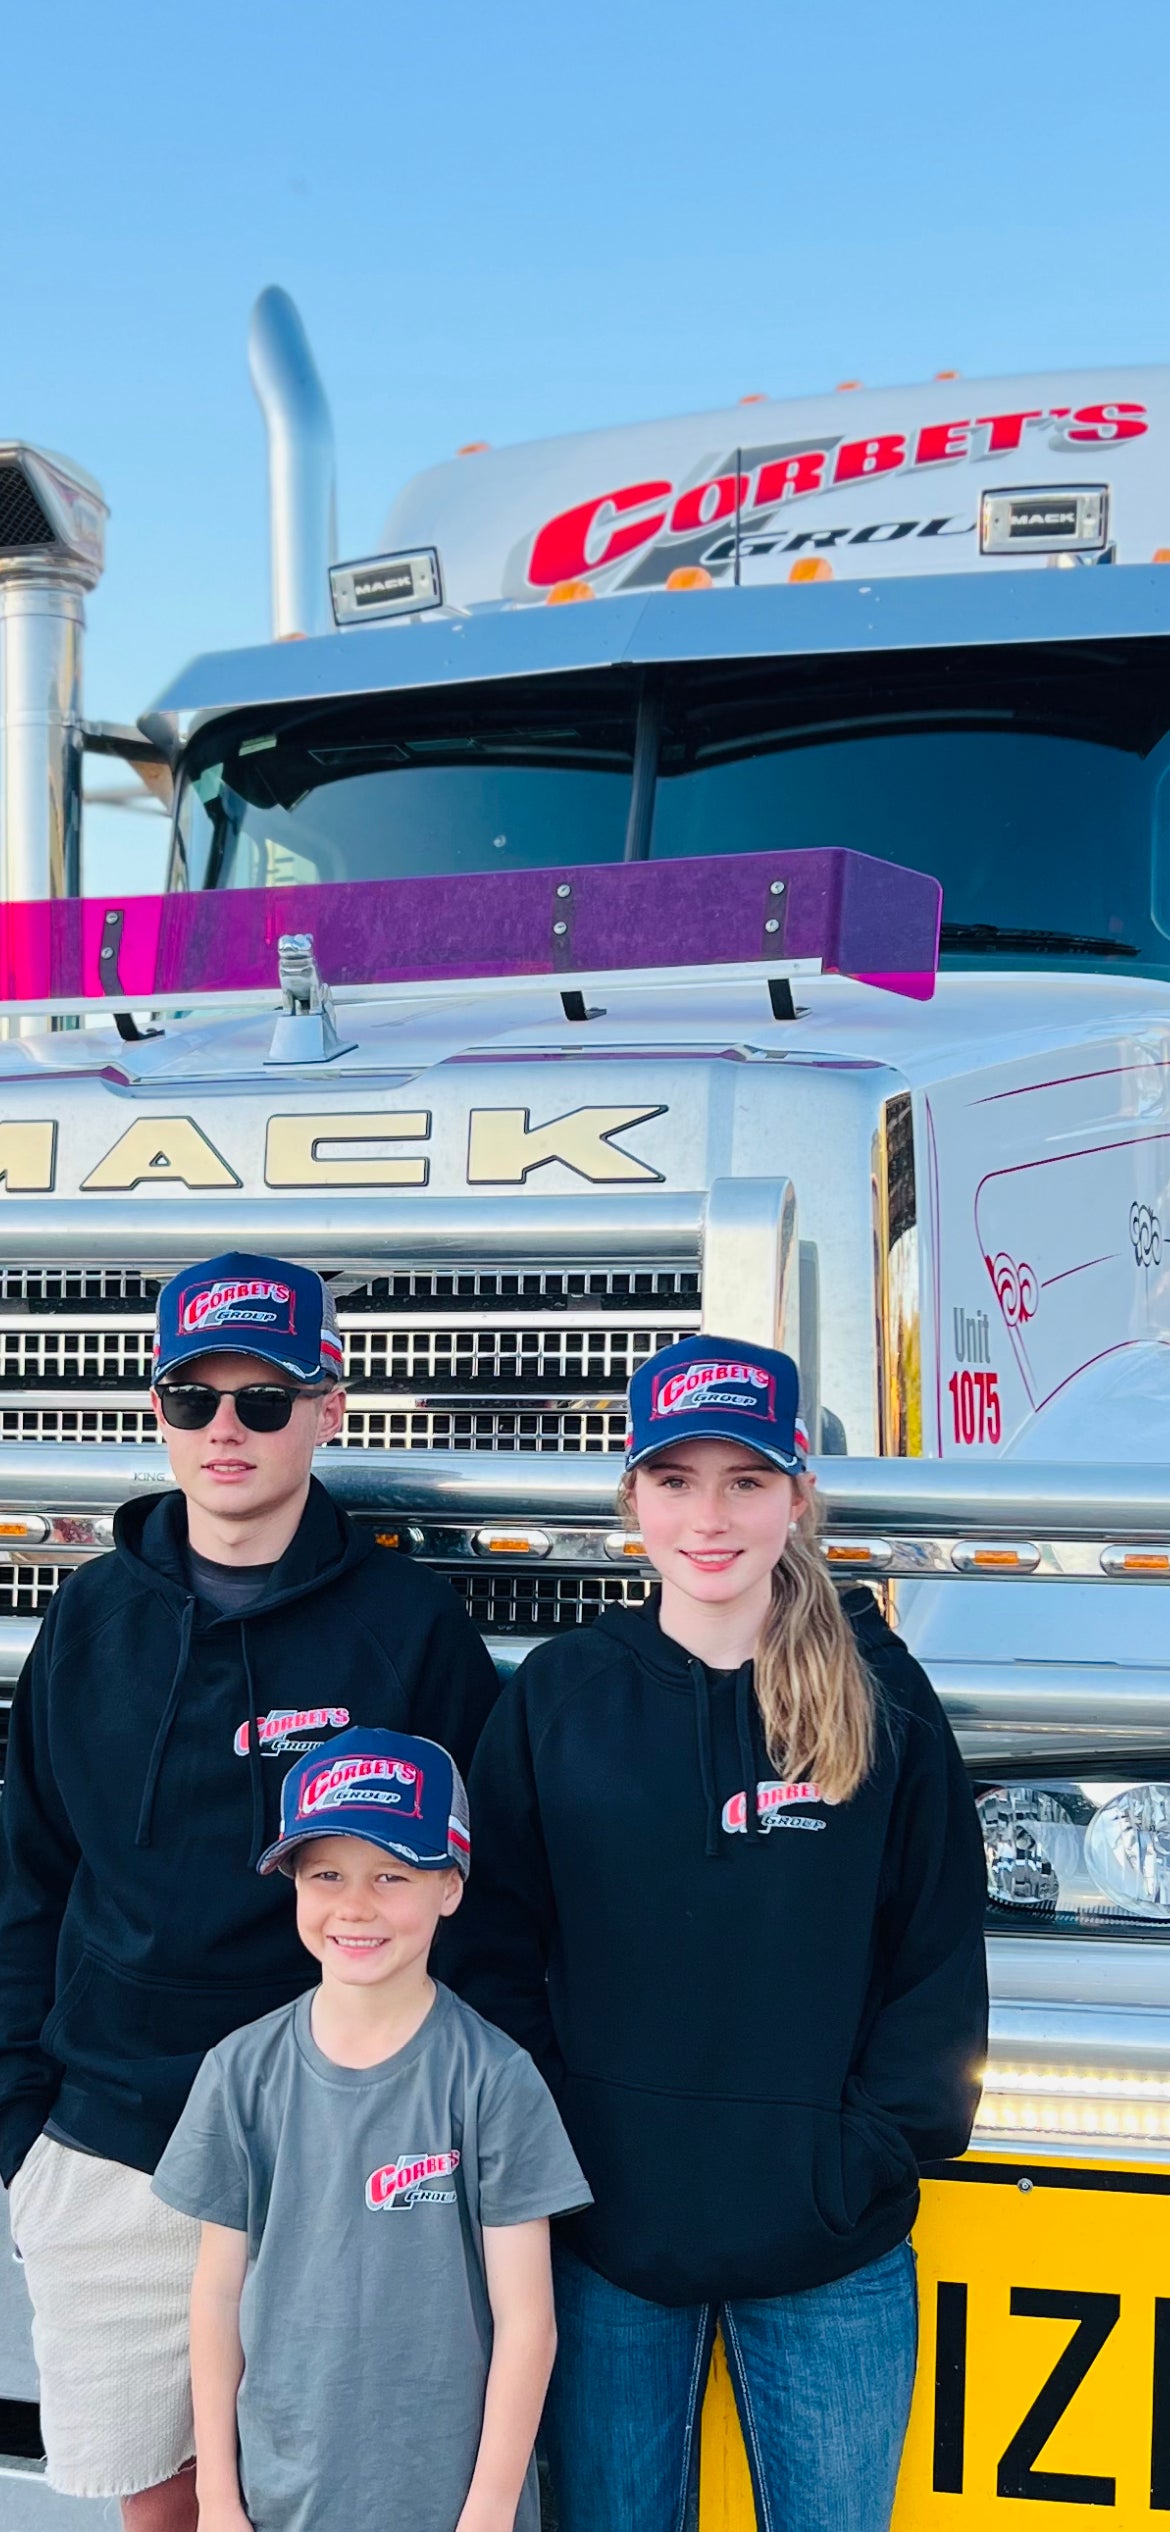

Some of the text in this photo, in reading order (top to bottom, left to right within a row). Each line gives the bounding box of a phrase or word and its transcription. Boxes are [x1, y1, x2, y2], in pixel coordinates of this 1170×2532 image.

[1010, 513, 1075, 525] MACK
[703, 516, 981, 562] GROU
[355, 576, 411, 595] MACK
[216, 1309, 277, 1321] GROUP
[953, 1307, 991, 1363] Unit
[693, 1393, 758, 1405] GROUP
[949, 1370, 1001, 1445] 1075
[335, 1790, 401, 1803] GROUP
